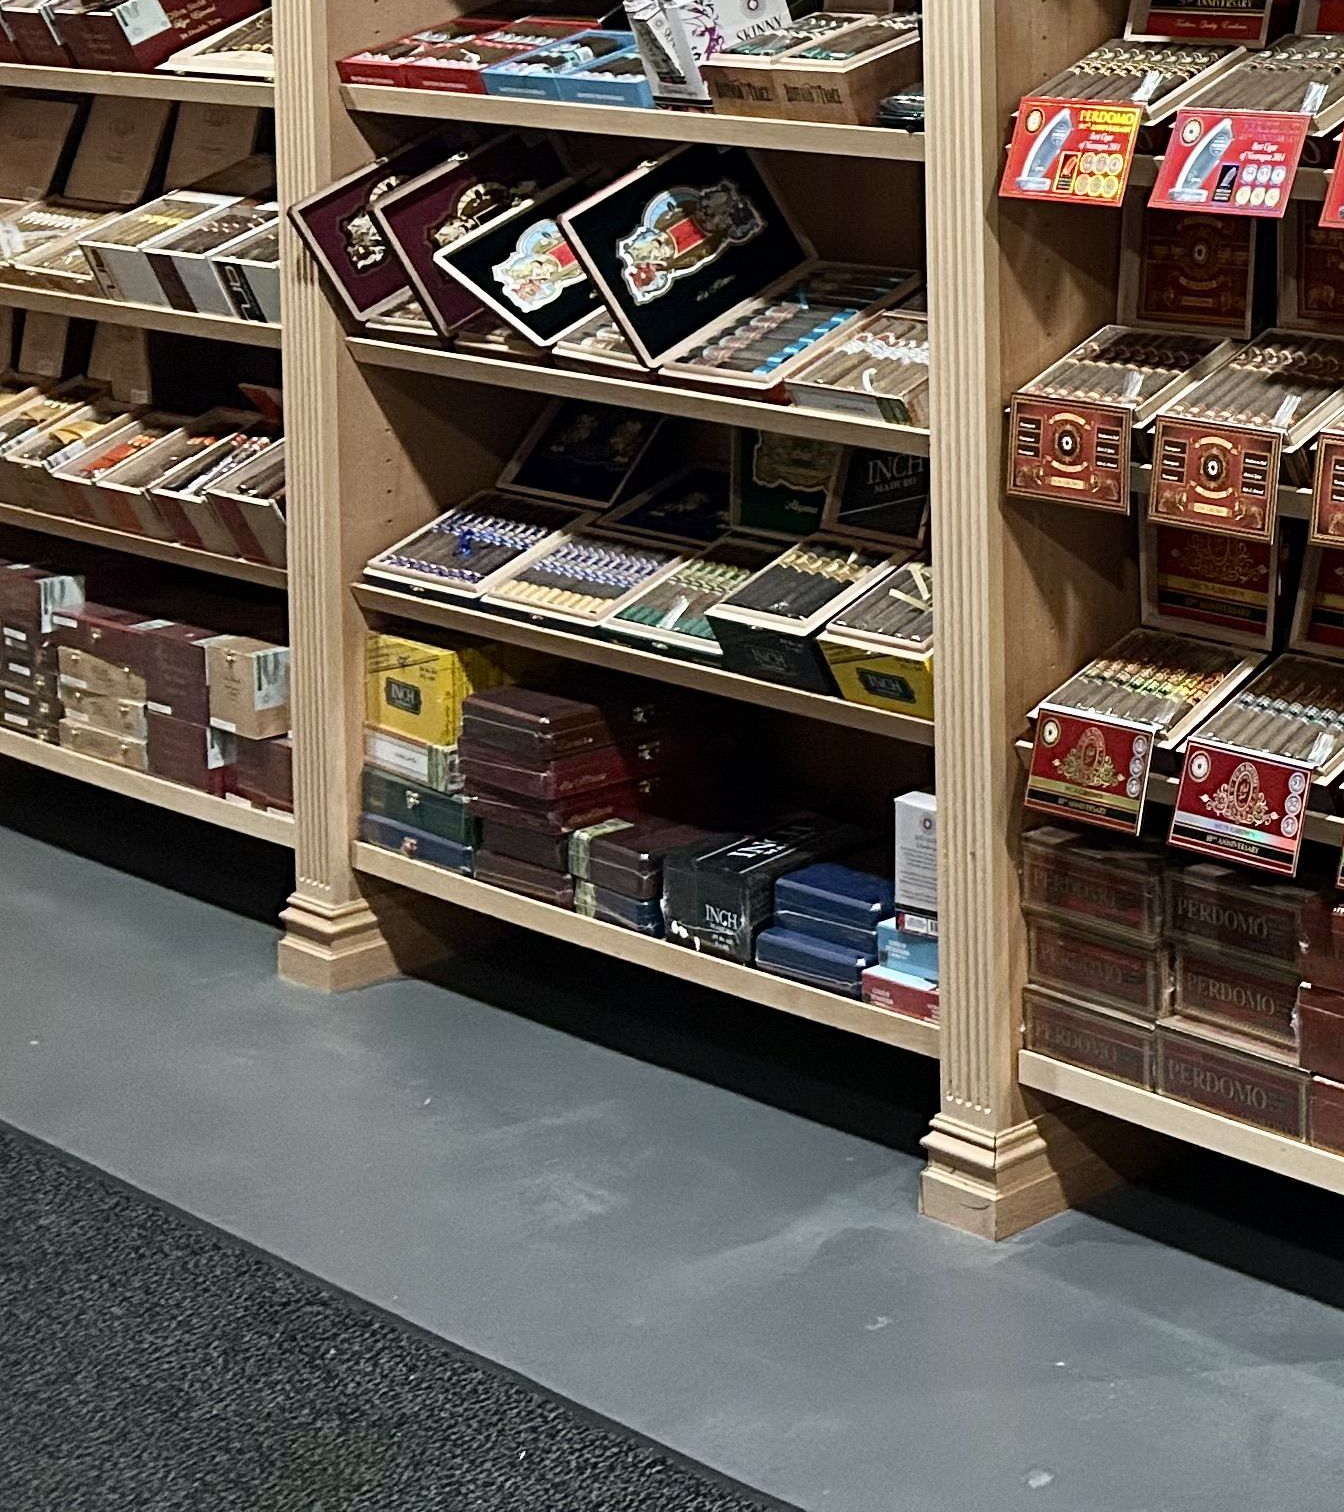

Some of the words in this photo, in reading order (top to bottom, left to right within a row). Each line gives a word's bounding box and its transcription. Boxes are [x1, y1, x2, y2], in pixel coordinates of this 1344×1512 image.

[736, 14, 782, 43] SKINNY
[866, 452, 925, 485] INCH
[388, 686, 416, 707] INCH
[705, 904, 738, 930] INCH
[1168, 1059, 1268, 1109] PERDOMO
